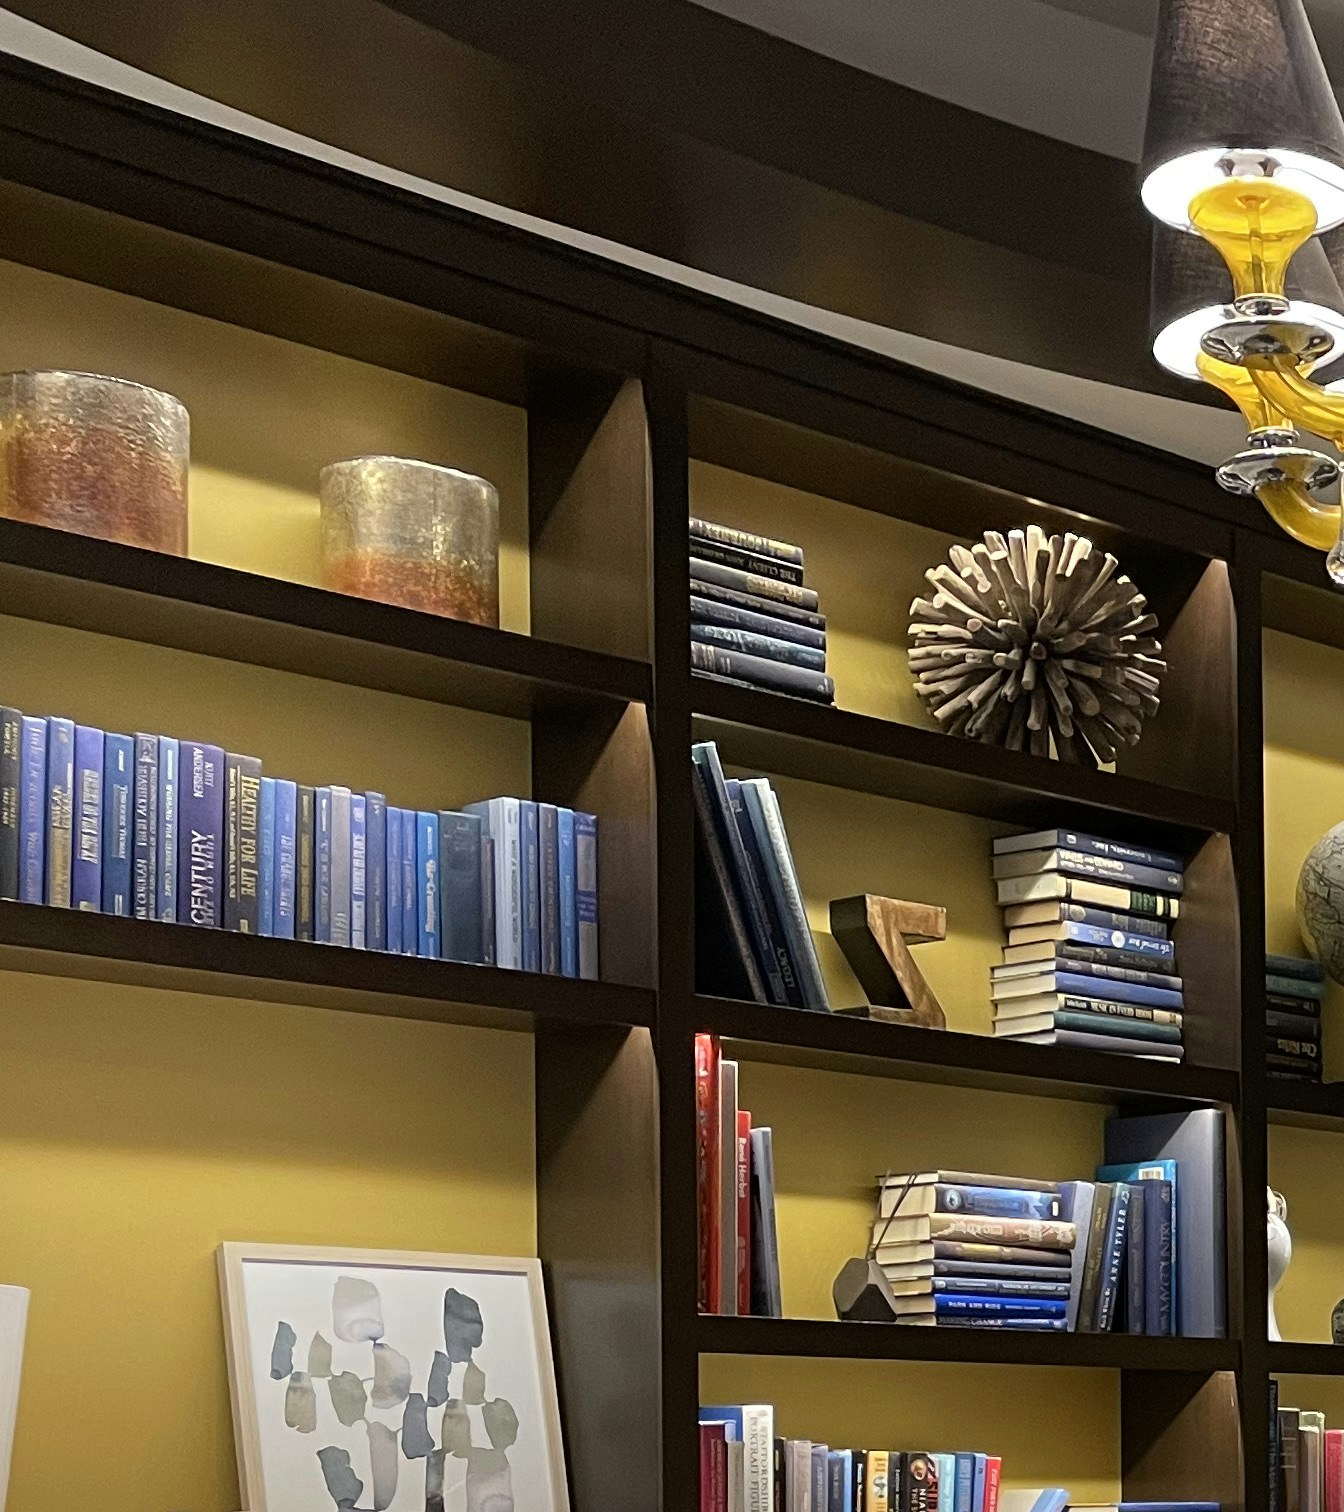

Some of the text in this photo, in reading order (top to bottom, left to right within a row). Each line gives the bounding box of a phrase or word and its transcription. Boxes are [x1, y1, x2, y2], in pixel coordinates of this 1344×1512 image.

[192, 747, 205, 798] ANDERSEN
[240, 775, 260, 898] HEALTHY FOR LIFE
[190, 829, 210, 926] CENTURY
[1109, 1209, 1127, 1282] TYLER ANNE
[749, 1416, 760, 1477] PORTRAIT
[910, 1488, 919, 1506] THE
